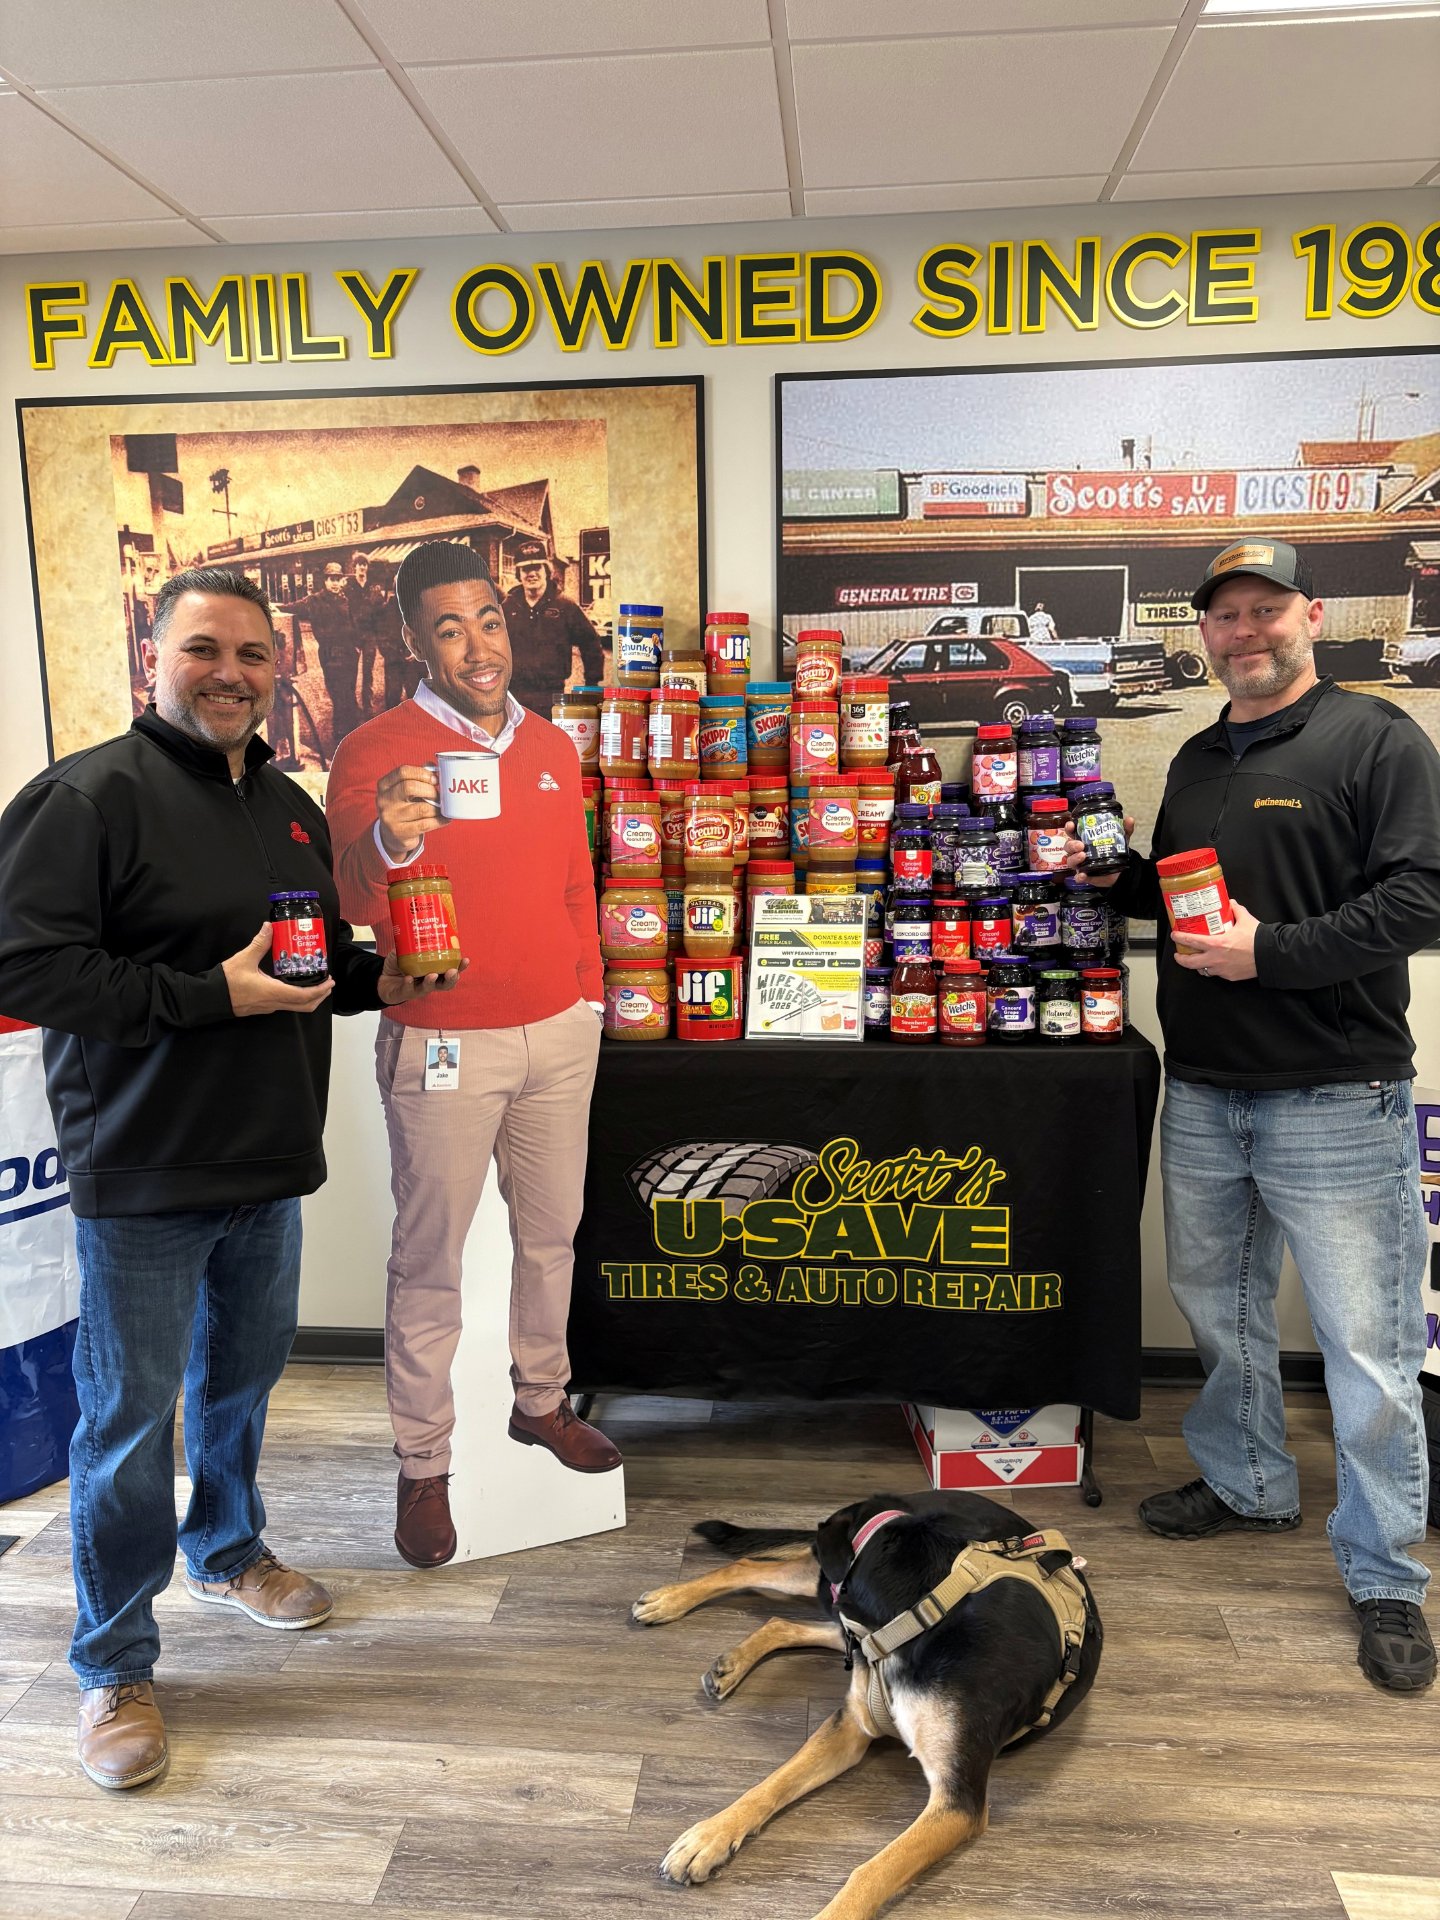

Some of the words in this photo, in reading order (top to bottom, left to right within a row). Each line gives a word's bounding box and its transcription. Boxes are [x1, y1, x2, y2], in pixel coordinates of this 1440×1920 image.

[25, 268, 418, 370] FAMILY
[451, 249, 882, 357] OWNED
[913, 227, 1262, 338] SINCE
[930, 481, 1019, 497] BFGoodrich
[1191, 476, 1208, 495] U
[1049, 475, 1163, 516] Scott's
[1244, 475, 1305, 512] CIGS
[1171, 494, 1226, 515] SAVE
[839, 586, 910, 606] GENERAL
[911, 585, 948, 602] TIRE
[1145, 606, 1189, 619] TIRES
[621, 643, 654, 654] chunky
[719, 636, 750, 660] Jif
[798, 668, 830, 682] Creamy
[851, 705, 865, 714] 365
[755, 714, 787, 734] SKIPPY
[846, 721, 871, 729] Creamy
[700, 728, 730, 748] SKIPPY
[811, 740, 835, 748] Creamy
[1067, 748, 1096, 765] Welch's
[448, 778, 489, 794] JAKE
[748, 819, 780, 830] reamy
[825, 814, 851, 823] Creamy
[626, 830, 653, 838] Creamy
[666, 821, 684, 833] Cre
[689, 823, 727, 840] Creamy
[1087, 820, 1116, 837] Welch's
[412, 917, 439, 925] Creamy
[630, 920, 658, 928] Creamy
[691, 907, 721, 925] Jif
[292, 933, 320, 941] Concord
[759, 933, 780, 941] FREE
[677, 971, 726, 1003] Jif
[757, 973, 796, 990] WIPE
[620, 1001, 649, 1009] Creamy
[760, 987, 810, 1007] HUNGER
[948, 1001, 976, 1014] Welch's
[792, 1137, 1007, 1214] Scott's
[601, 1262, 728, 1301] TIRES
[733, 1265, 771, 1303] &
[777, 1266, 898, 1306] AUTO
[903, 1268, 1062, 1312] REPAIR
